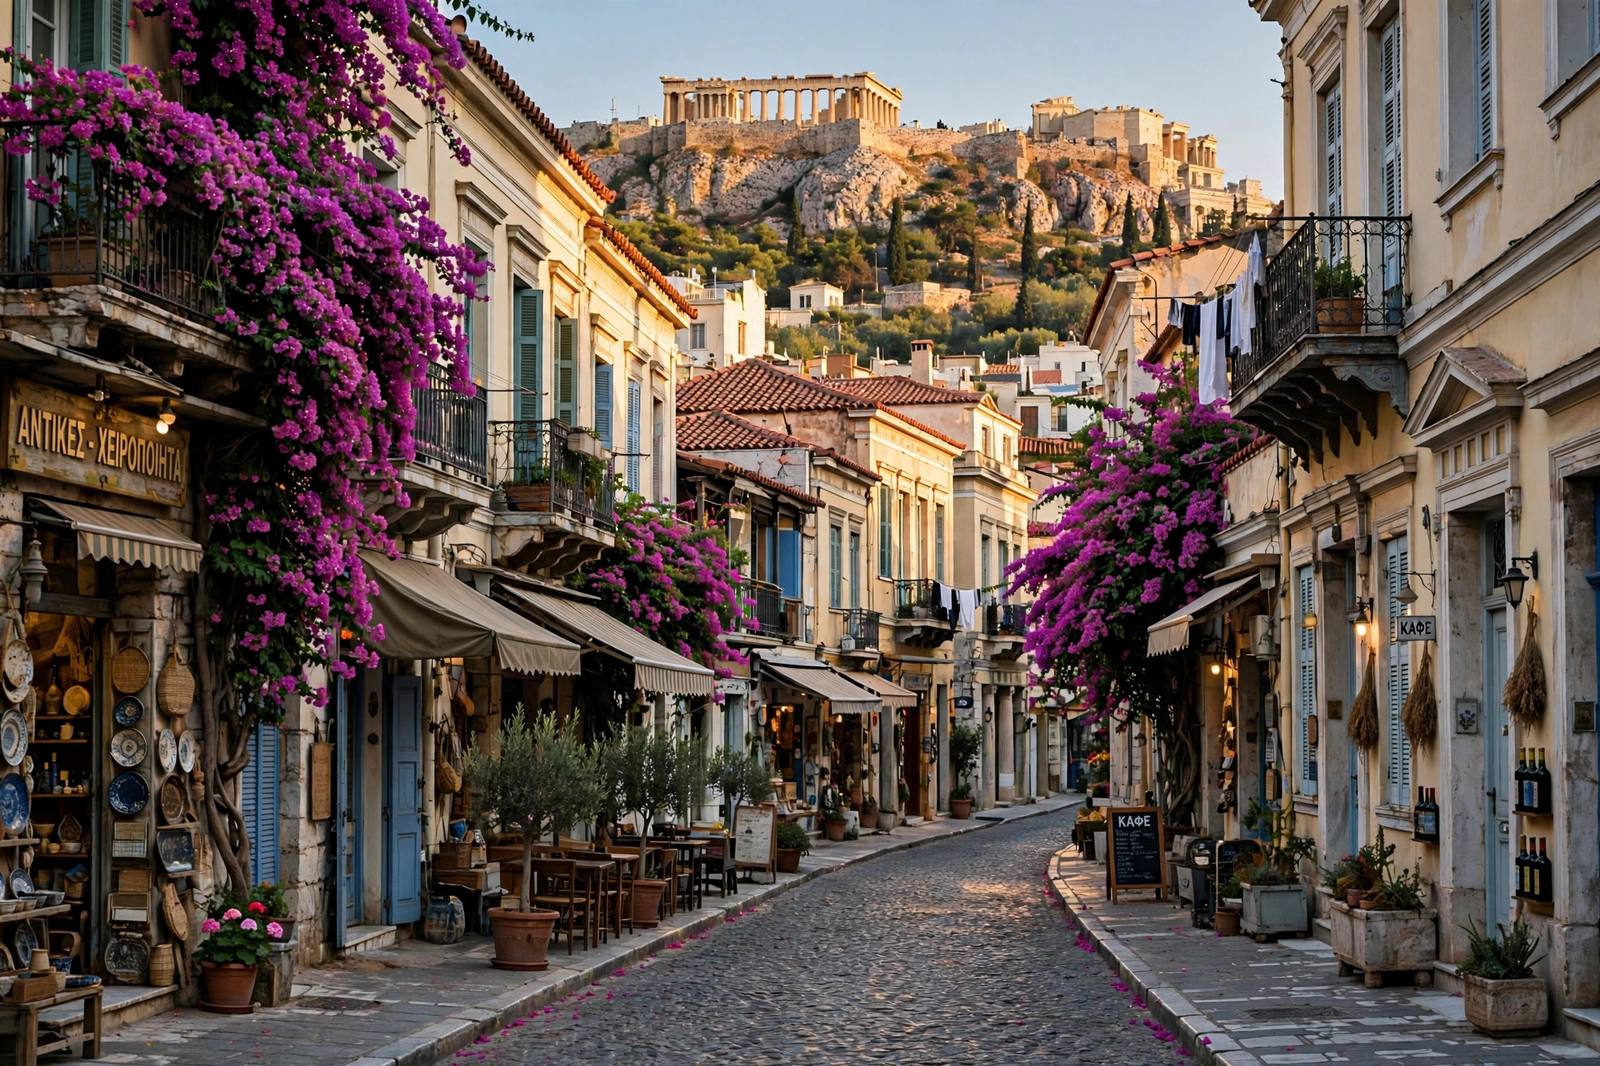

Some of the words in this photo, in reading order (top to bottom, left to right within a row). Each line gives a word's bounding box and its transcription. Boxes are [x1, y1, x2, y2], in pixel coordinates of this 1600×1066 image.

[18, 405, 86, 459] ΑΝΤΙΚΕΣ
[97, 426, 182, 482] ΧΕΙΡΟΠΟΙΗΤΑ
[1400, 621, 1432, 635] ΚΑΦΕ
[1118, 815, 1151, 828] ΚΑΦΕ
